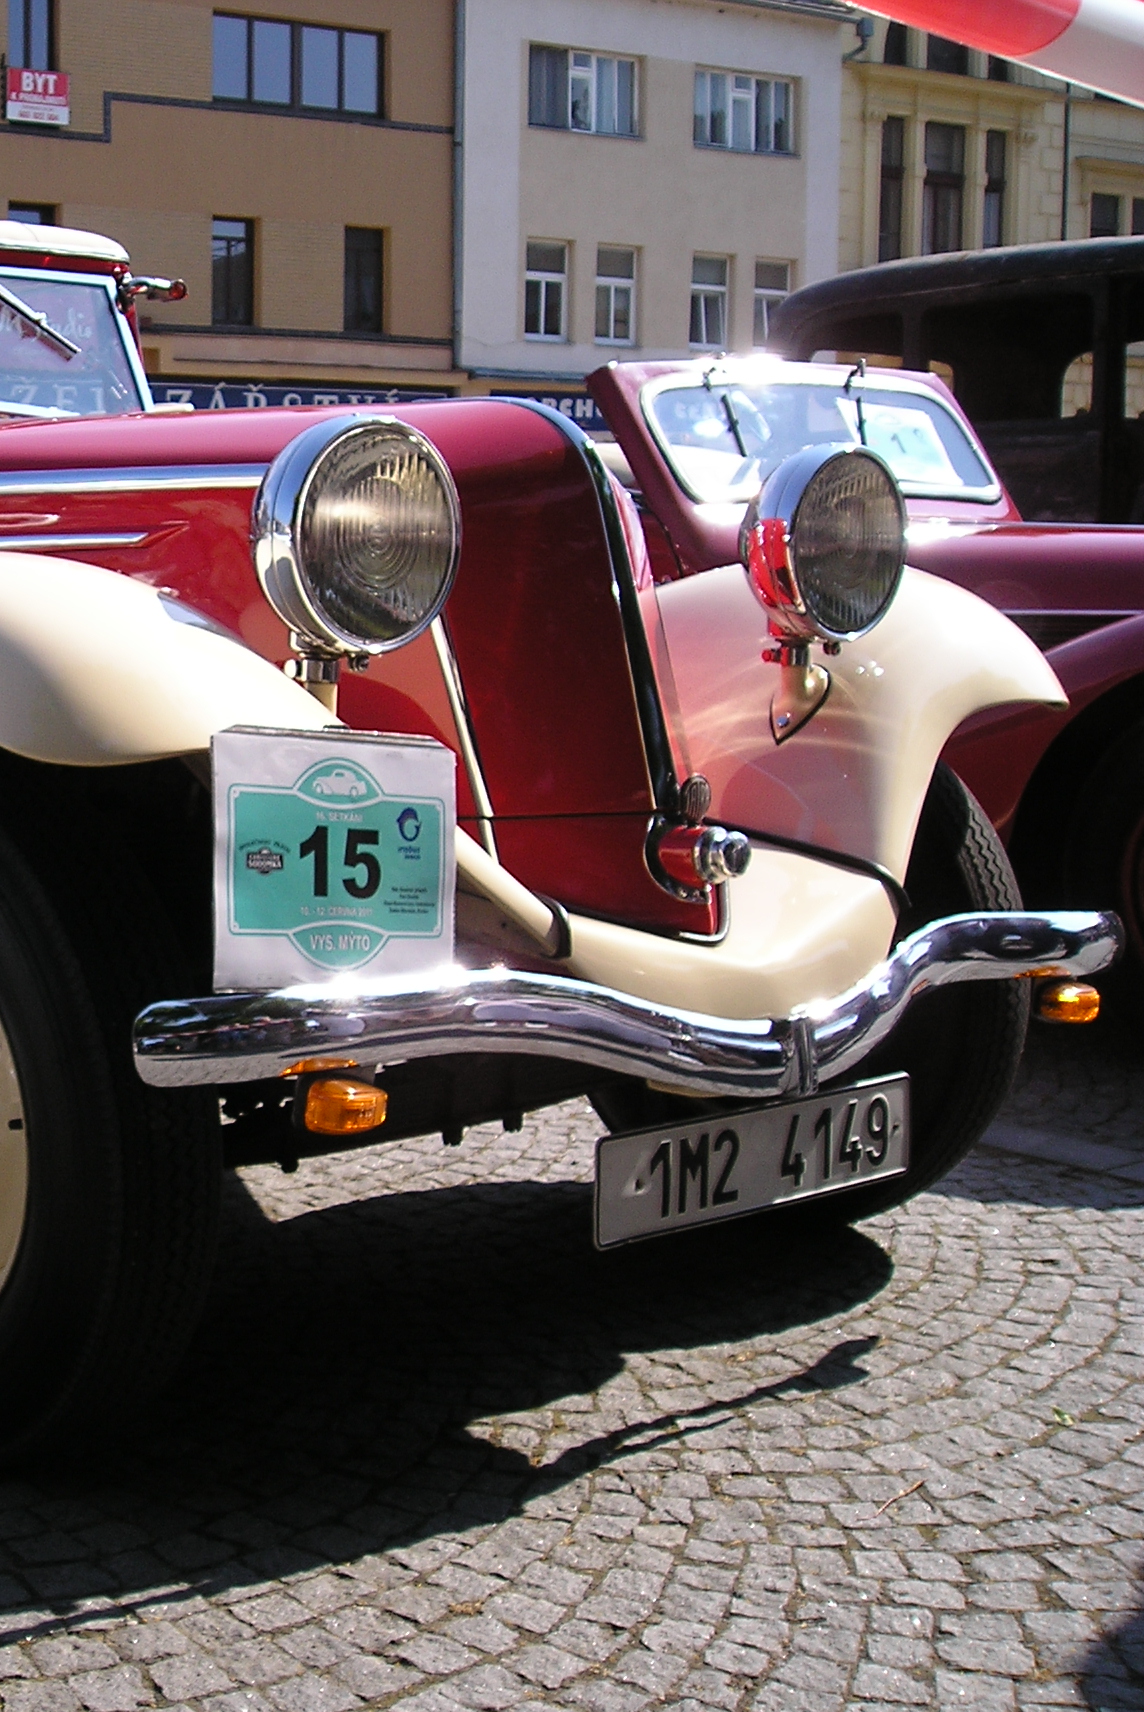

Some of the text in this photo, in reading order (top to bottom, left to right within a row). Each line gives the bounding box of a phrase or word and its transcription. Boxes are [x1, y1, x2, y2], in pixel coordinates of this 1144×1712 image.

[21, 71, 58, 94] BYT
[299, 825, 381, 899] 15
[310, 930, 371, 951] VYS. MÝTO
[650, 1093, 890, 1218] 1M2 4149
